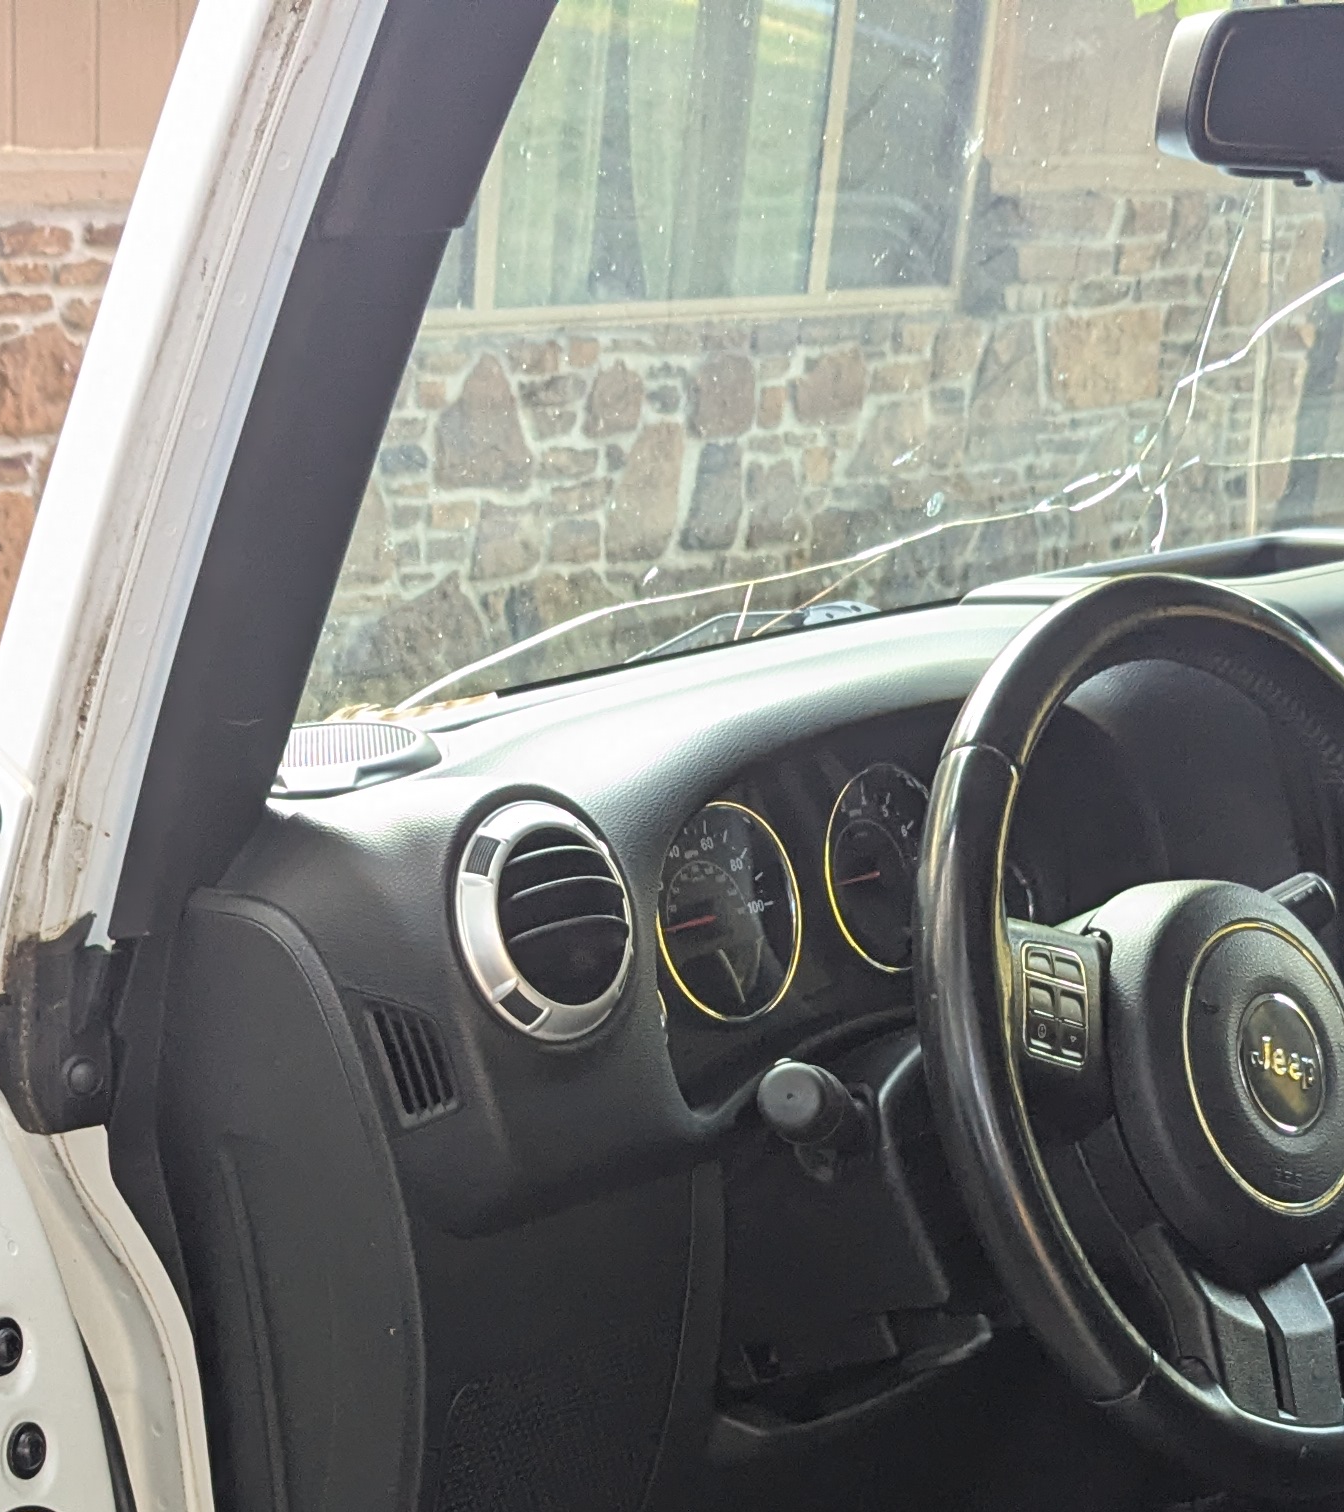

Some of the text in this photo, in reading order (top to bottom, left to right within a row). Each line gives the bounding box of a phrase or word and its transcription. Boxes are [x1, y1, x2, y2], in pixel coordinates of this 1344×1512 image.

[699, 836, 714, 851] 60
[729, 857, 744, 872] 80
[746, 899, 765, 914] 100
[1250, 1035, 1317, 1090] Jeep
